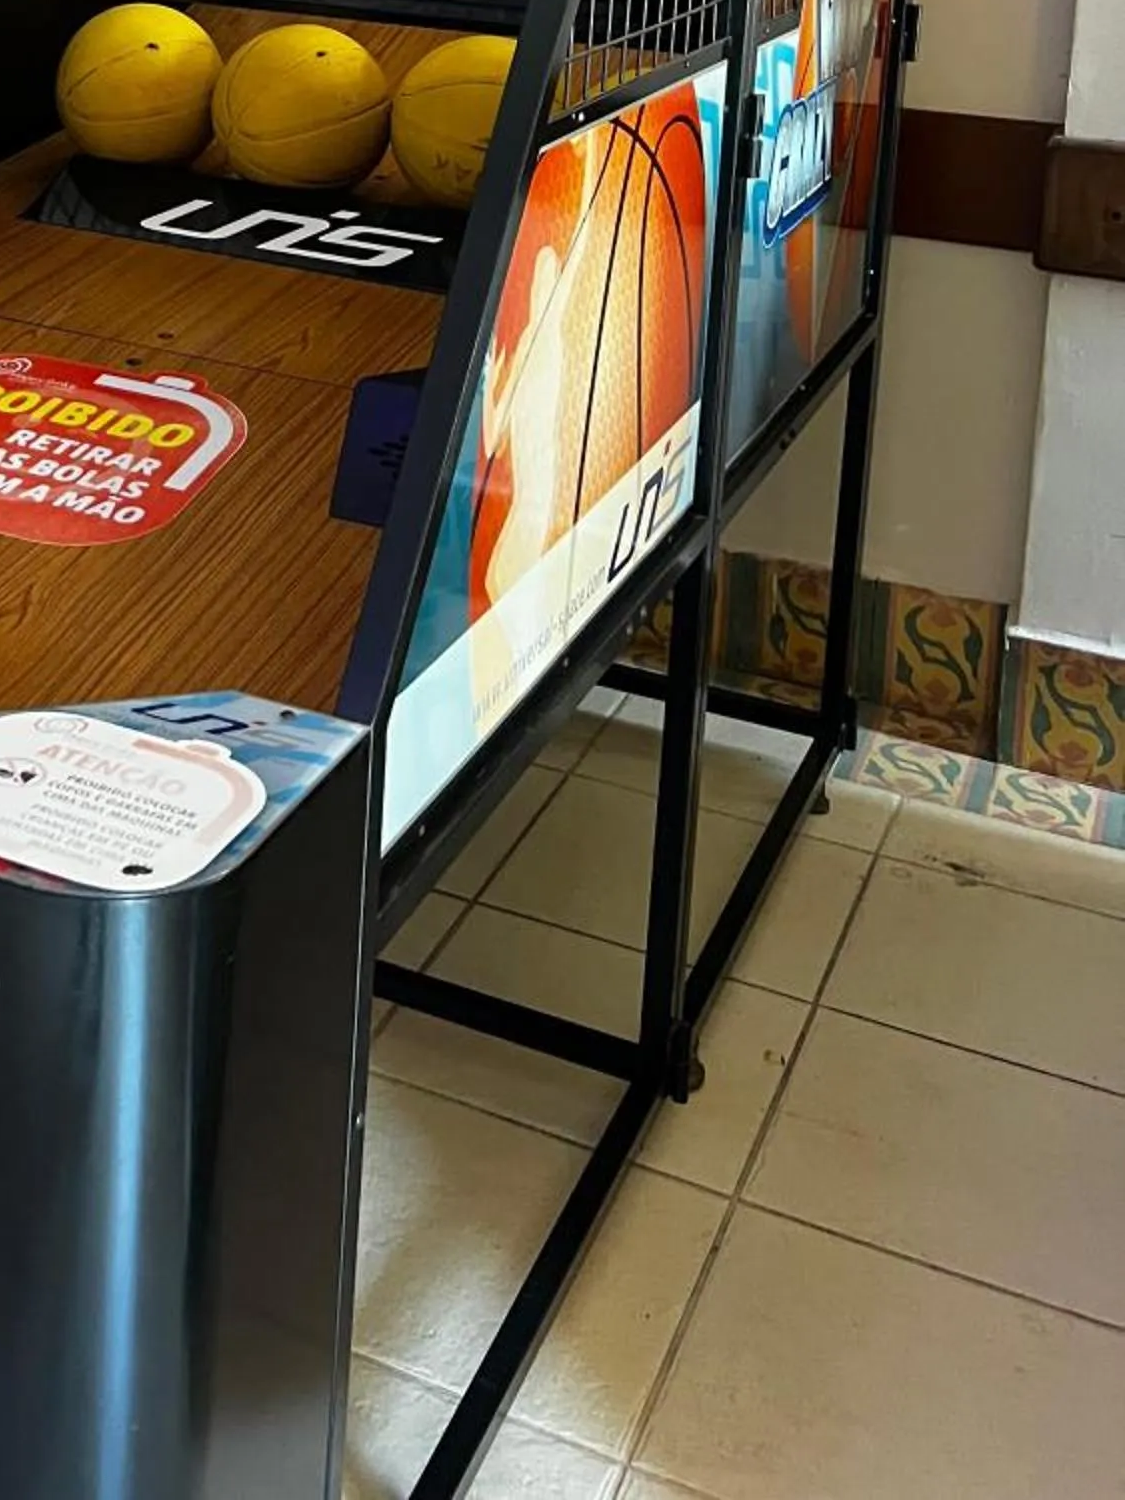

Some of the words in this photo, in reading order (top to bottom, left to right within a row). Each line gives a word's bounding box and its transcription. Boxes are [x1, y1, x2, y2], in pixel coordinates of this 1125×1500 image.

[6, 429, 162, 477] RETIRAR
[27, 459, 150, 500] BOLAS
[19, 484, 50, 503] A
[52, 491, 146, 524] MÃO
